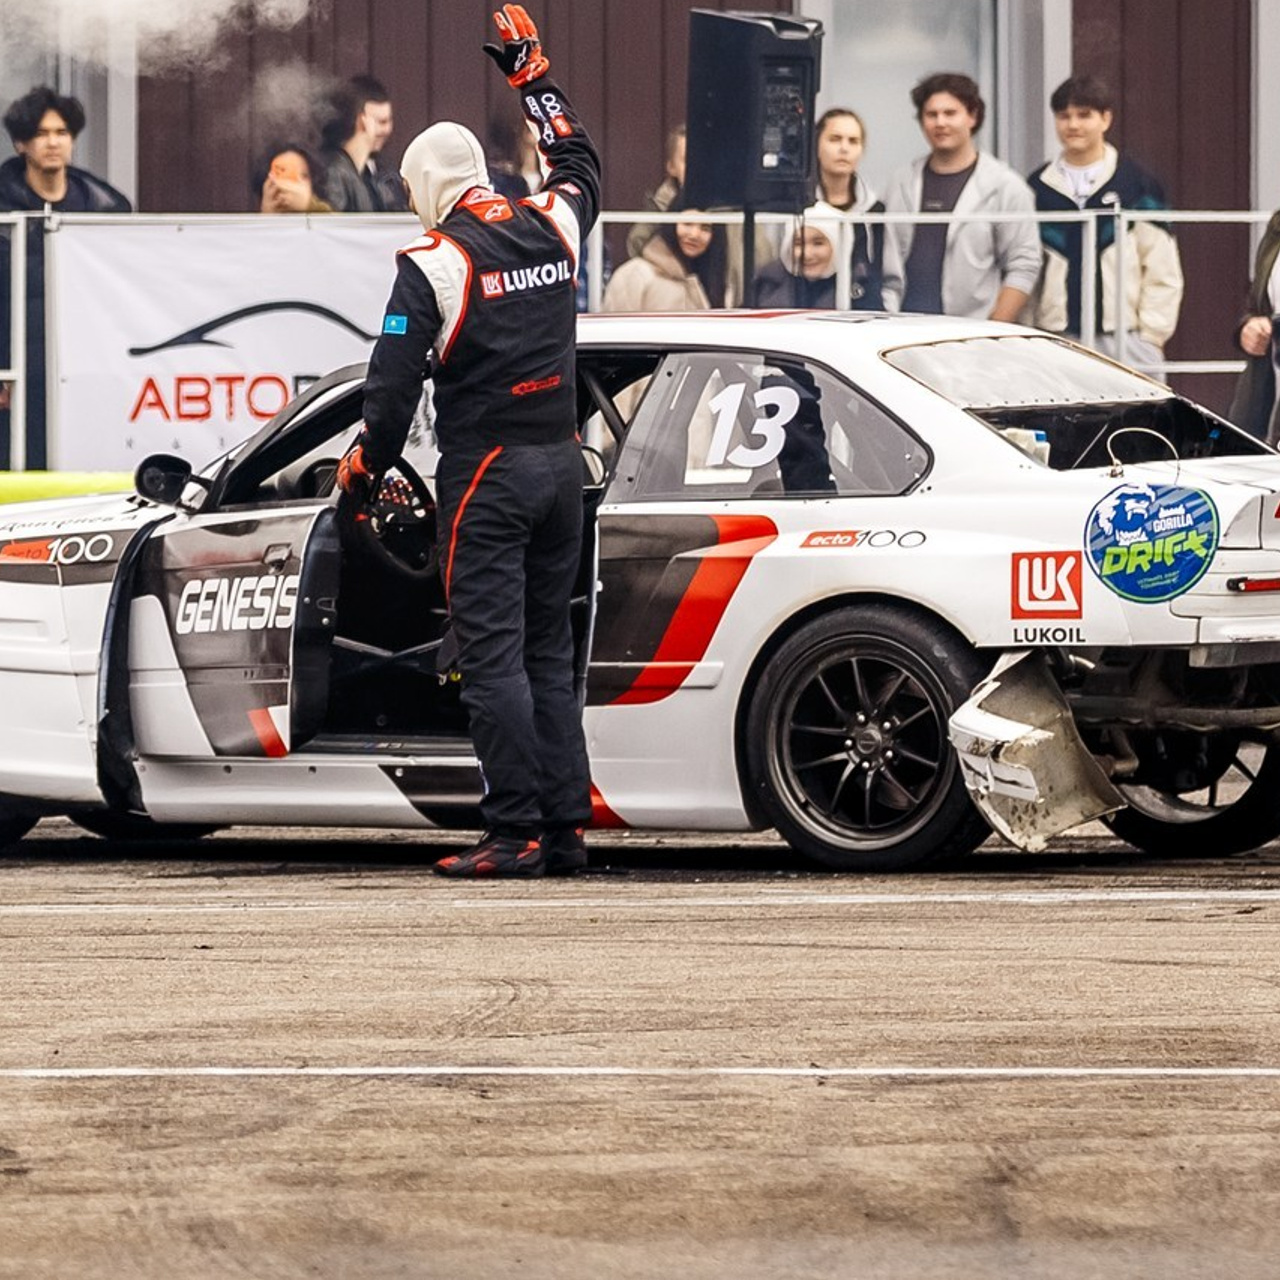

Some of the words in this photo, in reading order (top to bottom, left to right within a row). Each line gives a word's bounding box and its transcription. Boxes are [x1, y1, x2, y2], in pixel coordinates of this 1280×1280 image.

[503, 259, 571, 293] LUKOIL
[705, 381, 800, 468] 13
[1152, 512, 1195, 534] GORILLA
[1100, 529, 1209, 576] DRIFT
[175, 574, 300, 635] GENESIS
[1012, 626, 1087, 644] LUKOIL
